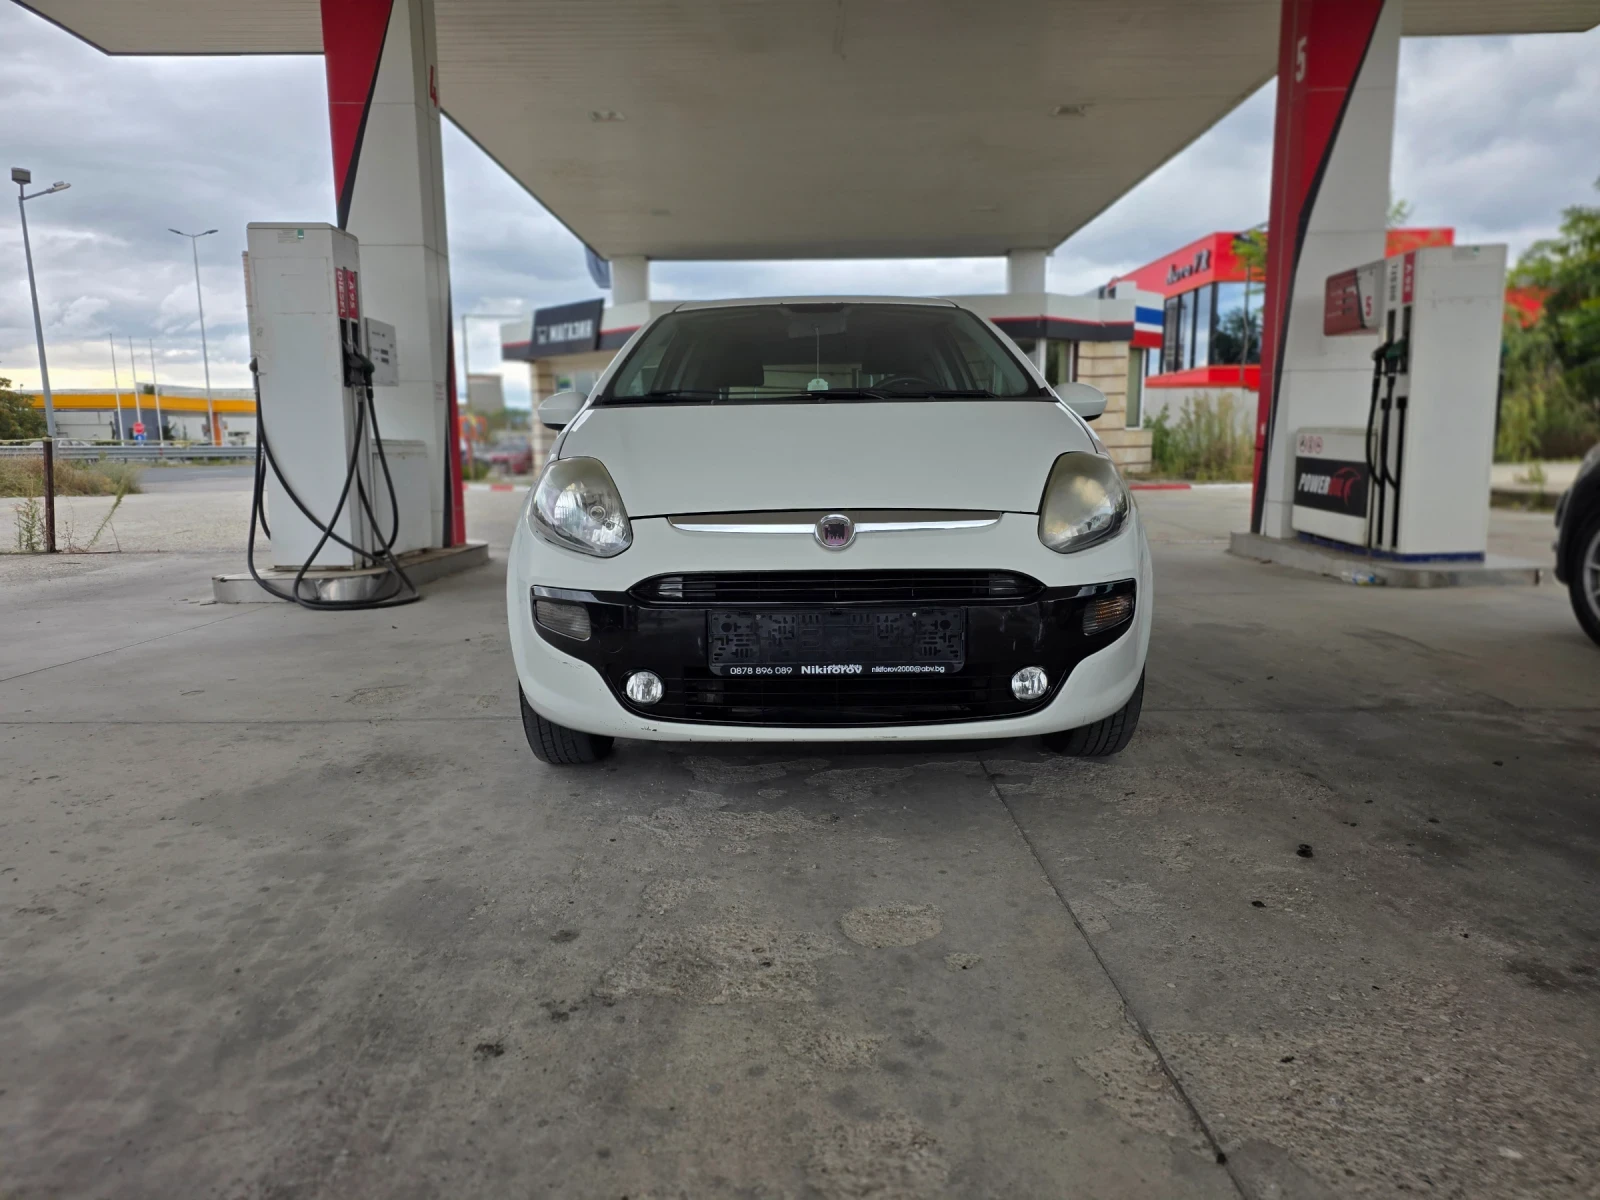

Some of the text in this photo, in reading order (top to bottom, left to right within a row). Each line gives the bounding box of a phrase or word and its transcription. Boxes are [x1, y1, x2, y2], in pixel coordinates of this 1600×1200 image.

[1296, 36, 1307, 82] 5
[337, 270, 346, 315] DIESEL
[729, 666, 753, 675] 0878
[755, 666, 773, 675] 896
[774, 666, 793, 675] 089
[801, 664, 863, 675] Nikiforov
